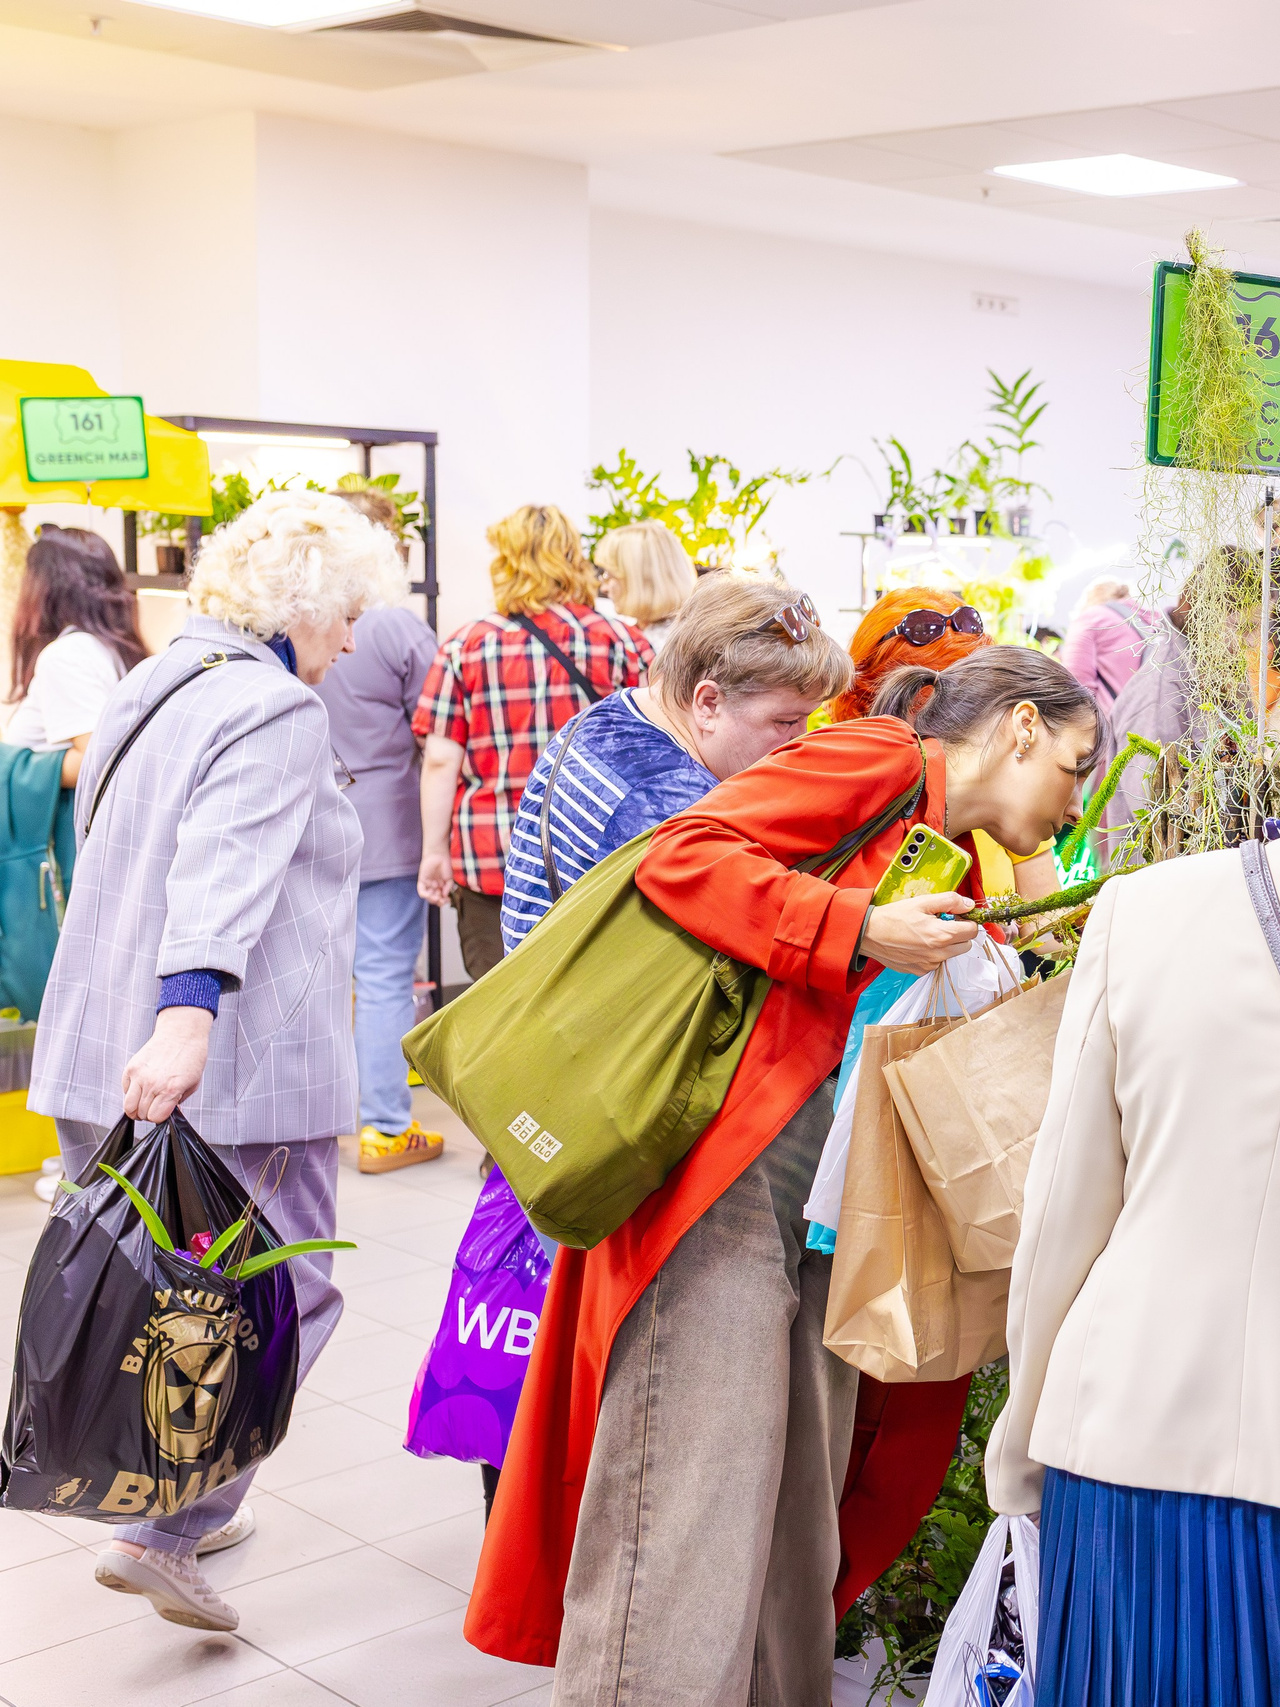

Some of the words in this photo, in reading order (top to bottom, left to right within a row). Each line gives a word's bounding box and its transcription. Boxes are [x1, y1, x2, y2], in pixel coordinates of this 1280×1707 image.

[70, 413, 103, 431] 161
[533, 1142, 552, 1158] QLO
[540, 1134, 558, 1150] UNI
[458, 1296, 540, 1356] WB
